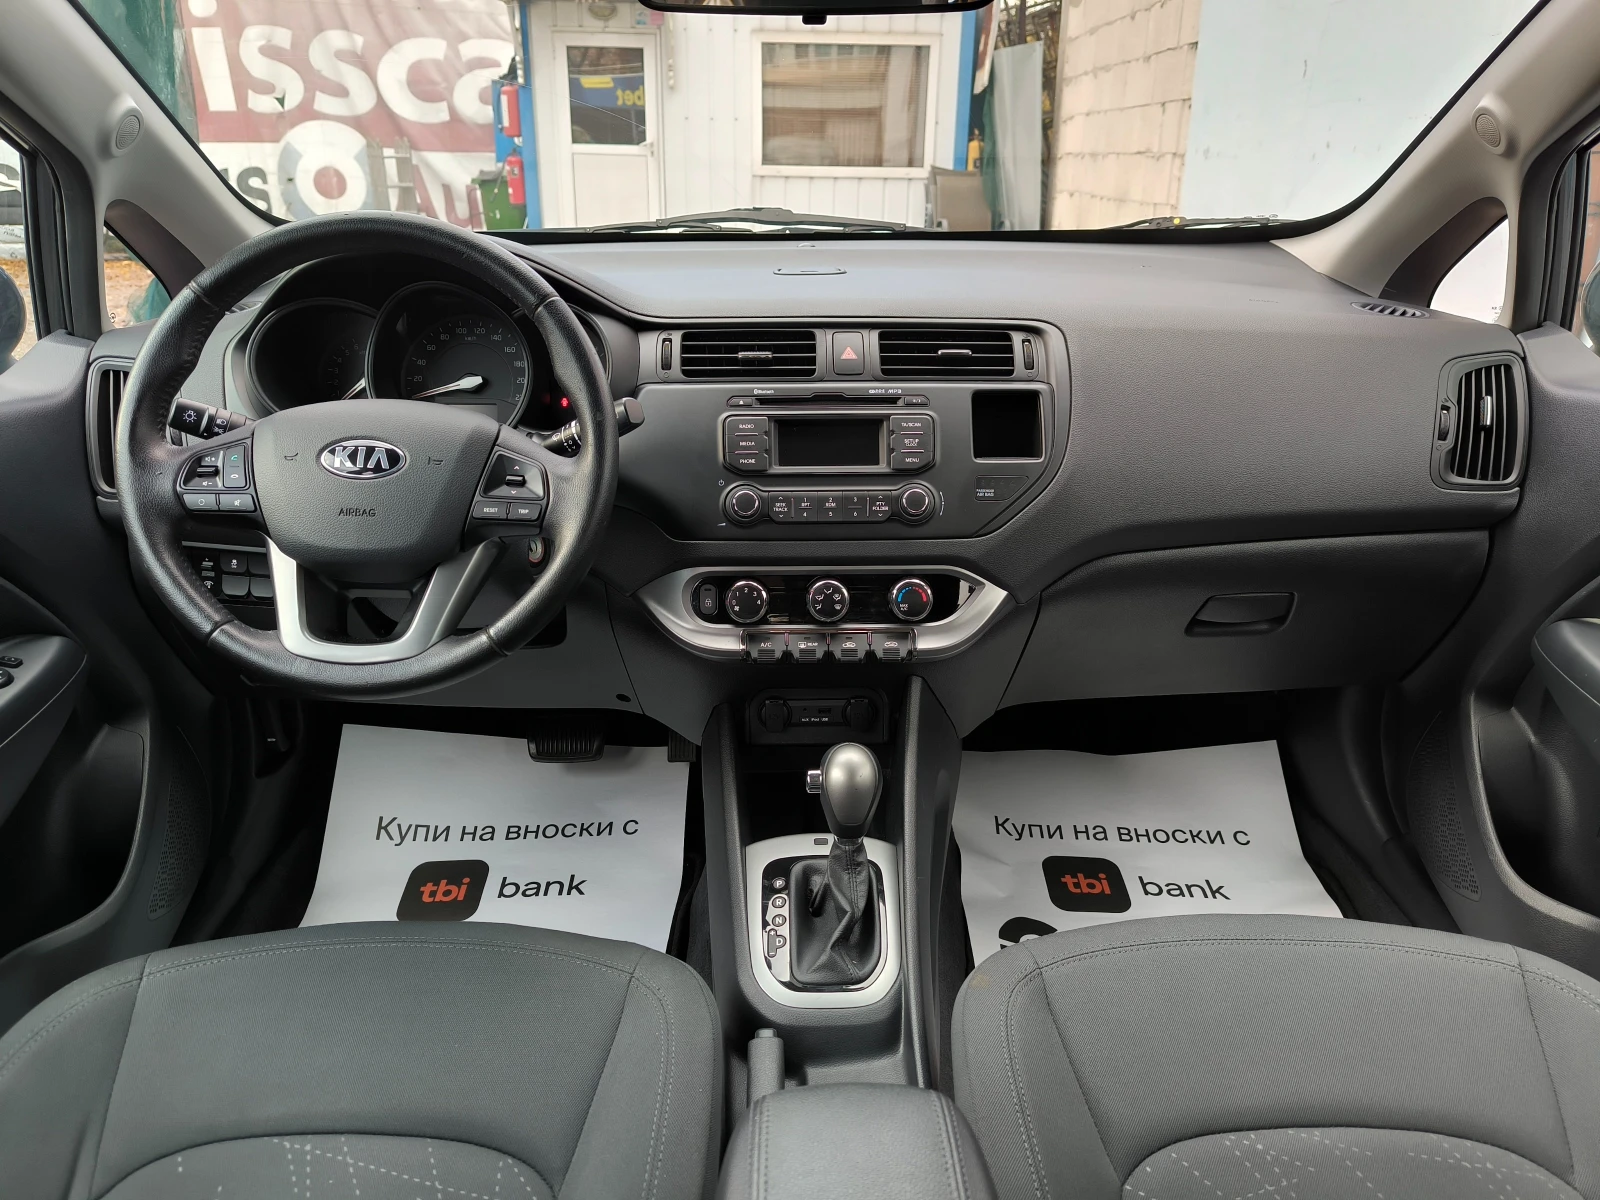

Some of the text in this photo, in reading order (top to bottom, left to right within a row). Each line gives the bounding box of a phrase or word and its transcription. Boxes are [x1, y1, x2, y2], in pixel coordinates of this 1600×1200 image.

[333, 446, 390, 470] KIA
[338, 507, 377, 517] AIRBAG
[375, 815, 640, 847] Купи на вноски с
[994, 815, 1251, 846] Купи на вноски с
[419, 874, 588, 903] tbi bank
[1061, 873, 1232, 900] tbi bank
[776, 938, 783, 946] D
